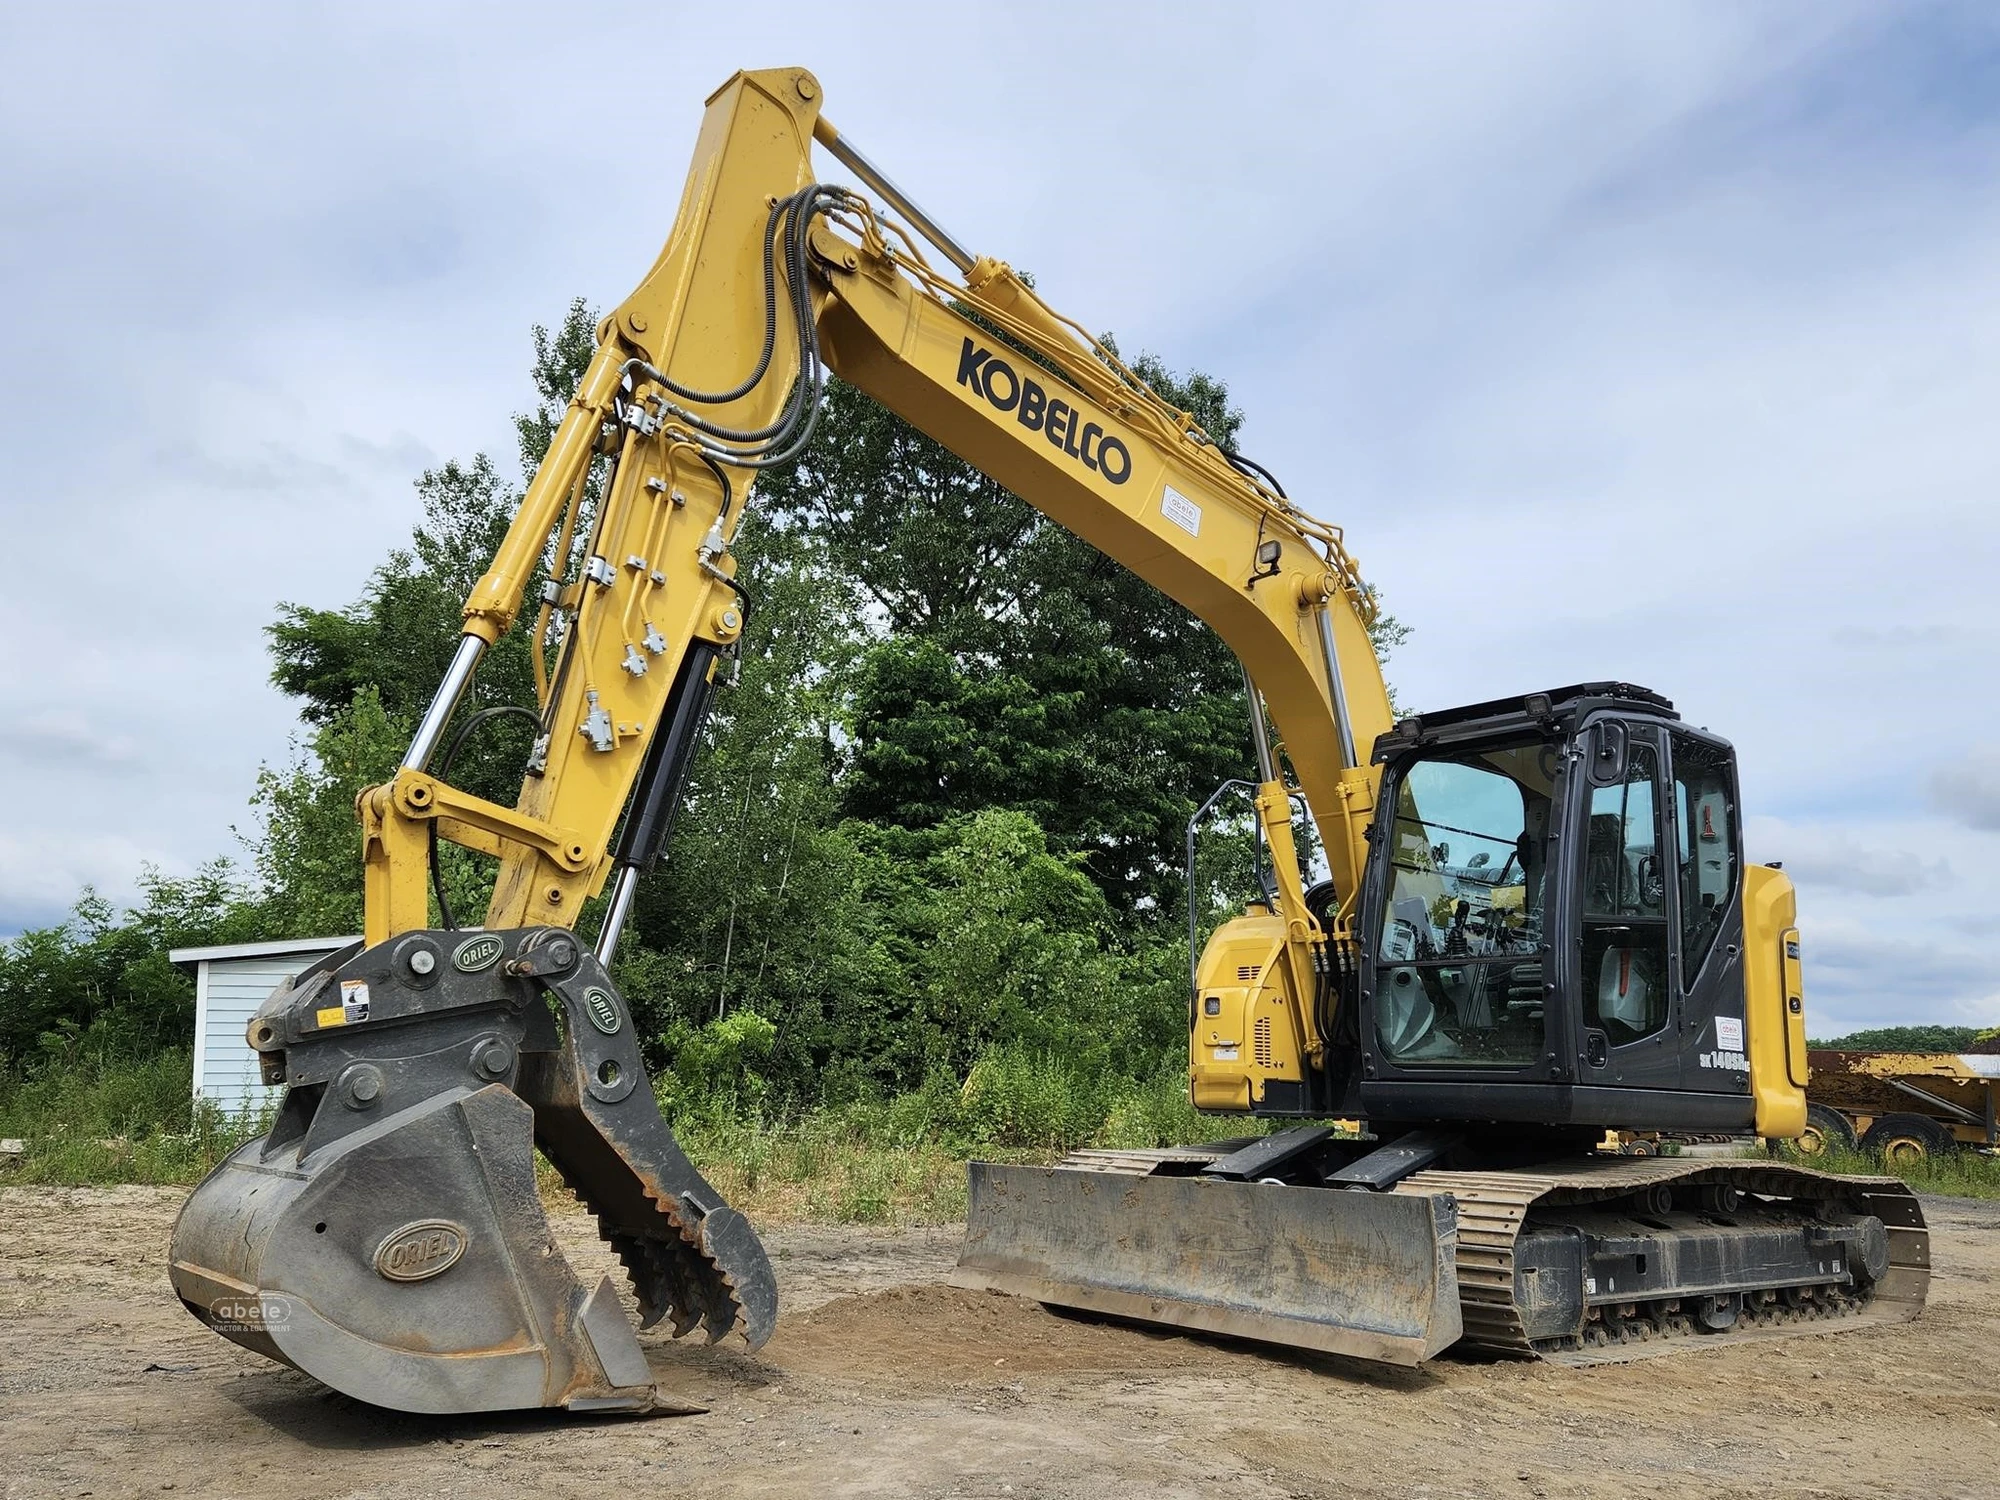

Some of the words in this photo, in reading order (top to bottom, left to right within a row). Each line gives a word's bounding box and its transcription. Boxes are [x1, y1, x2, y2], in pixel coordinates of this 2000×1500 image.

[957, 336, 1132, 485] KOBELCO
[463, 942, 494, 965] ORIEL
[590, 995, 615, 1025] ORIEL
[391, 1232, 452, 1269] ORIEL
